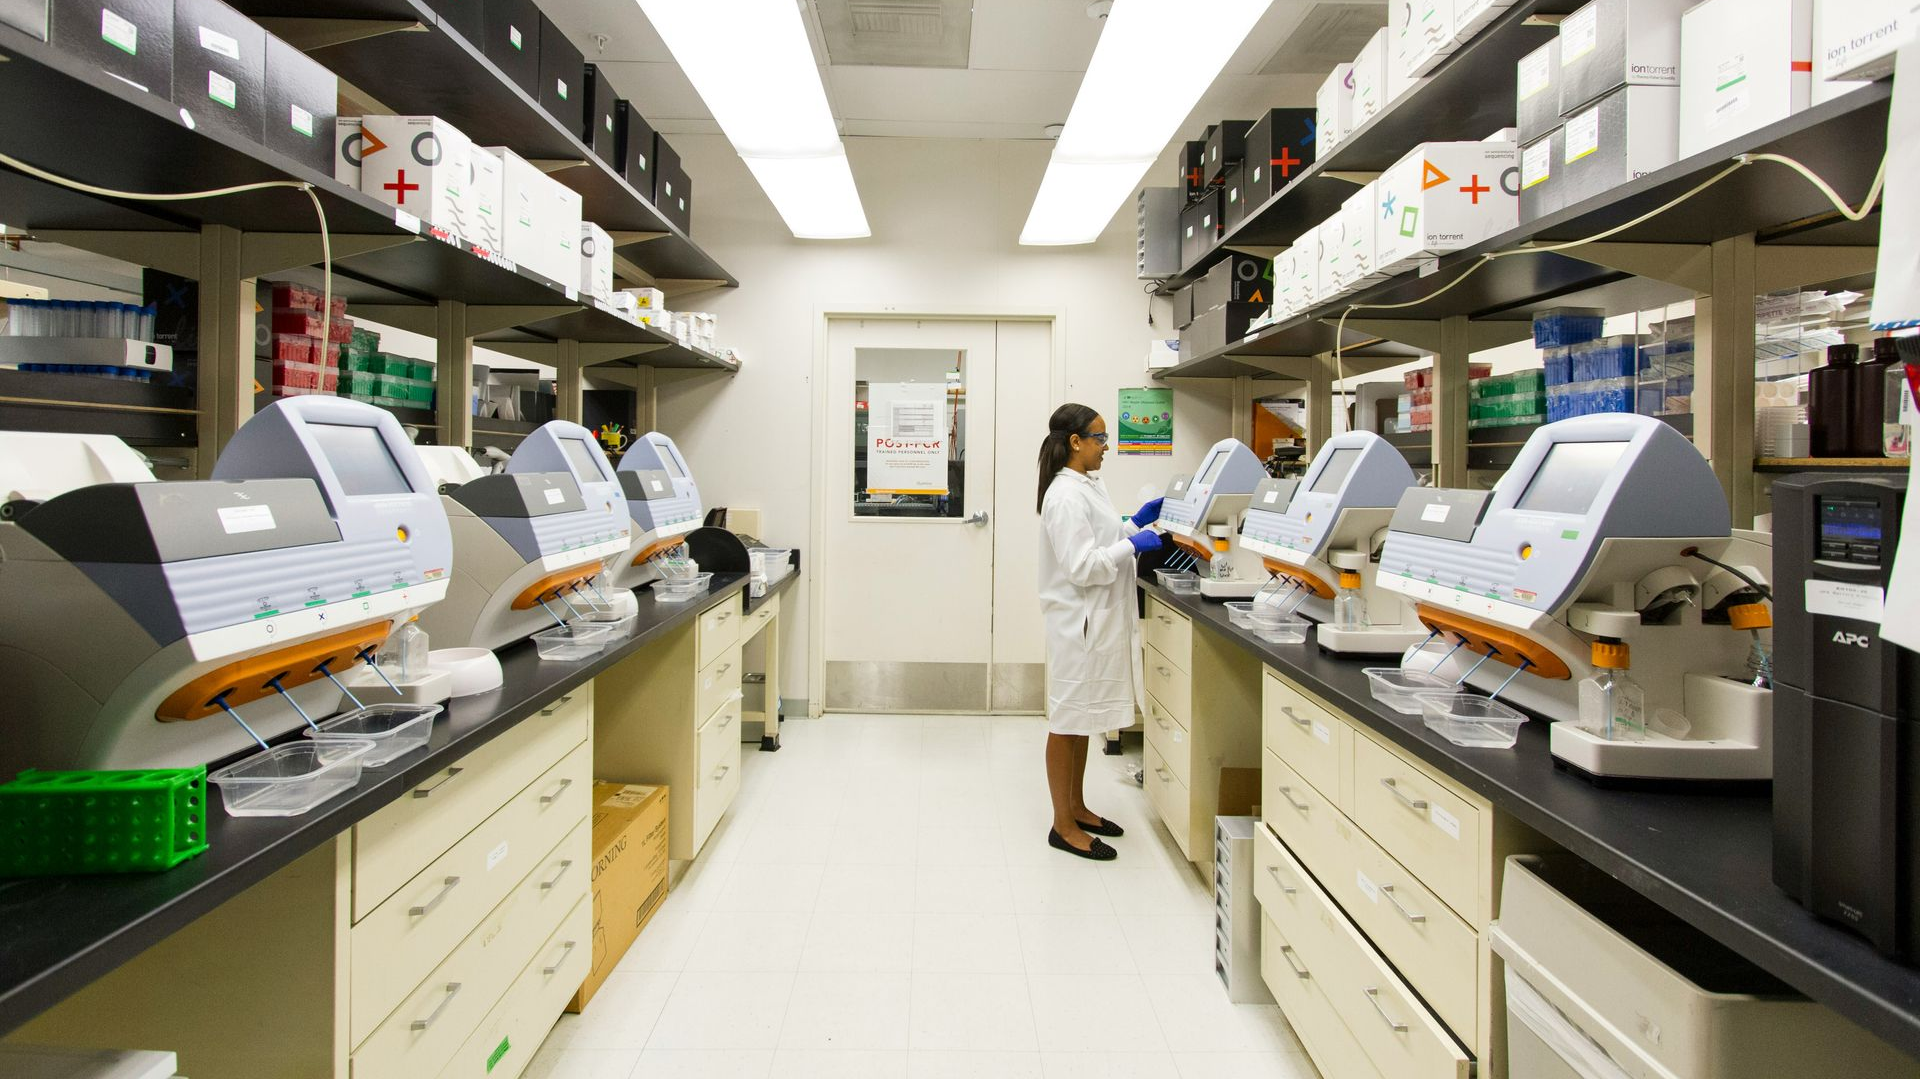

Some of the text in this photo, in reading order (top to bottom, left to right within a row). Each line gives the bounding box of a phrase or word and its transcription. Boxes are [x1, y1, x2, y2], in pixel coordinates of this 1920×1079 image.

[1827, 45, 1847, 61] ion
[1850, 19, 1899, 51] torrent
[1426, 232, 1464, 241] ion torrent
[1832, 630, 1870, 648] APC
